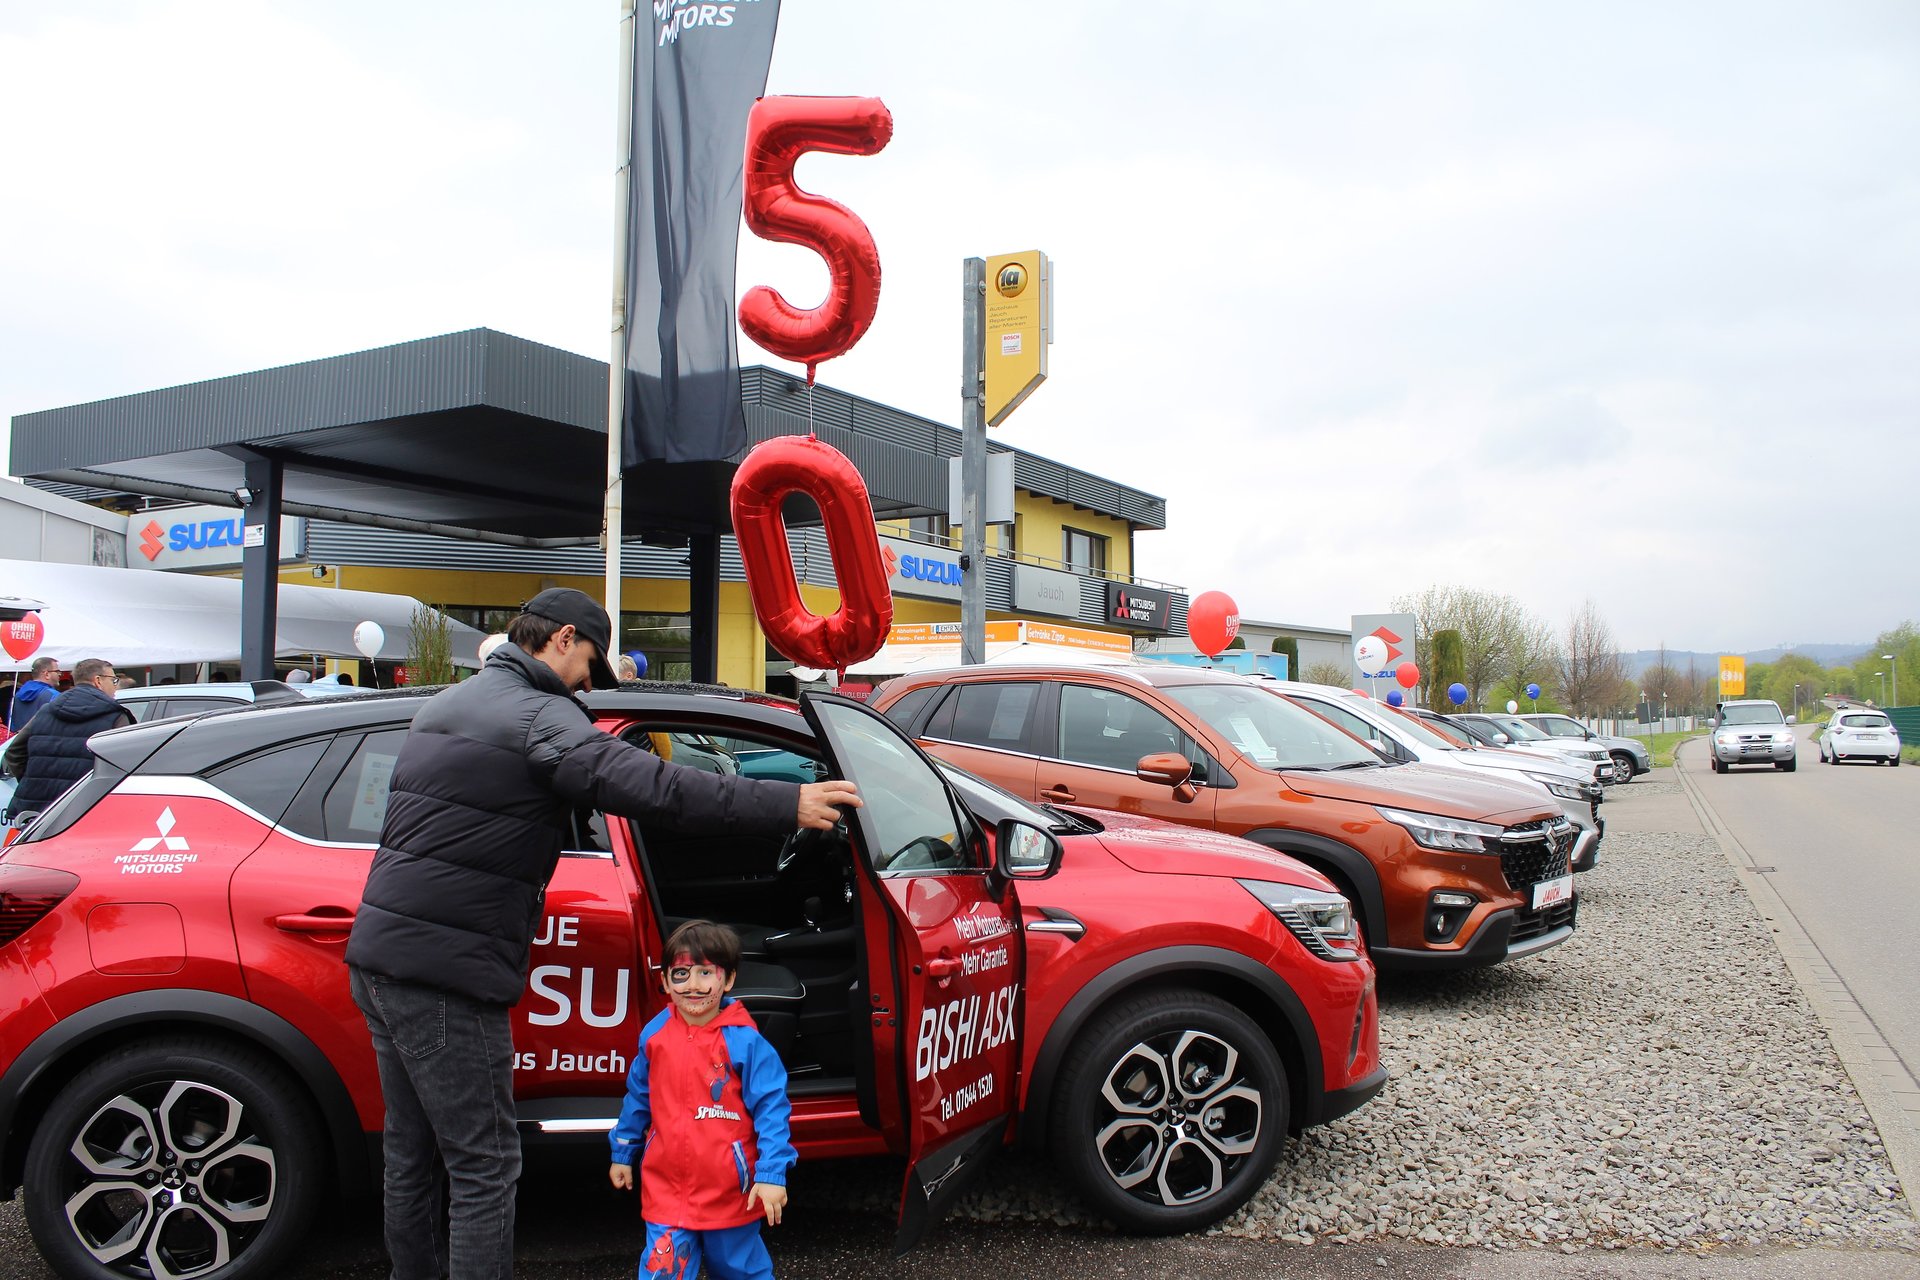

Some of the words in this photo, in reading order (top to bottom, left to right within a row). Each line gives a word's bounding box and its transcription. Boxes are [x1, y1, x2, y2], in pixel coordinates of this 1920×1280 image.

[659, 4, 736, 46] MTORS
[1038, 583, 1065, 601] Jauch
[1130, 597, 1156, 611] MITSUBISHI
[1130, 609, 1150, 622] MOTORS
[11, 622, 36, 632] OHHH
[11, 631, 36, 640] YEAH!
[113, 853, 198, 864] MITSUBISHI
[121, 863, 184, 874] MOTORS
[952, 914, 976, 940] Mehr
[961, 949, 980, 977] Mehr
[981, 943, 1008, 971] Garantie.
[916, 994, 981, 1082] BISHI
[977, 983, 1018, 1055] ASX
[546, 1049, 626, 1073] Jauch
[941, 1093, 954, 1122] Tel.
[956, 1083, 977, 1113] 07644
[978, 1073, 993, 1104] 1520
